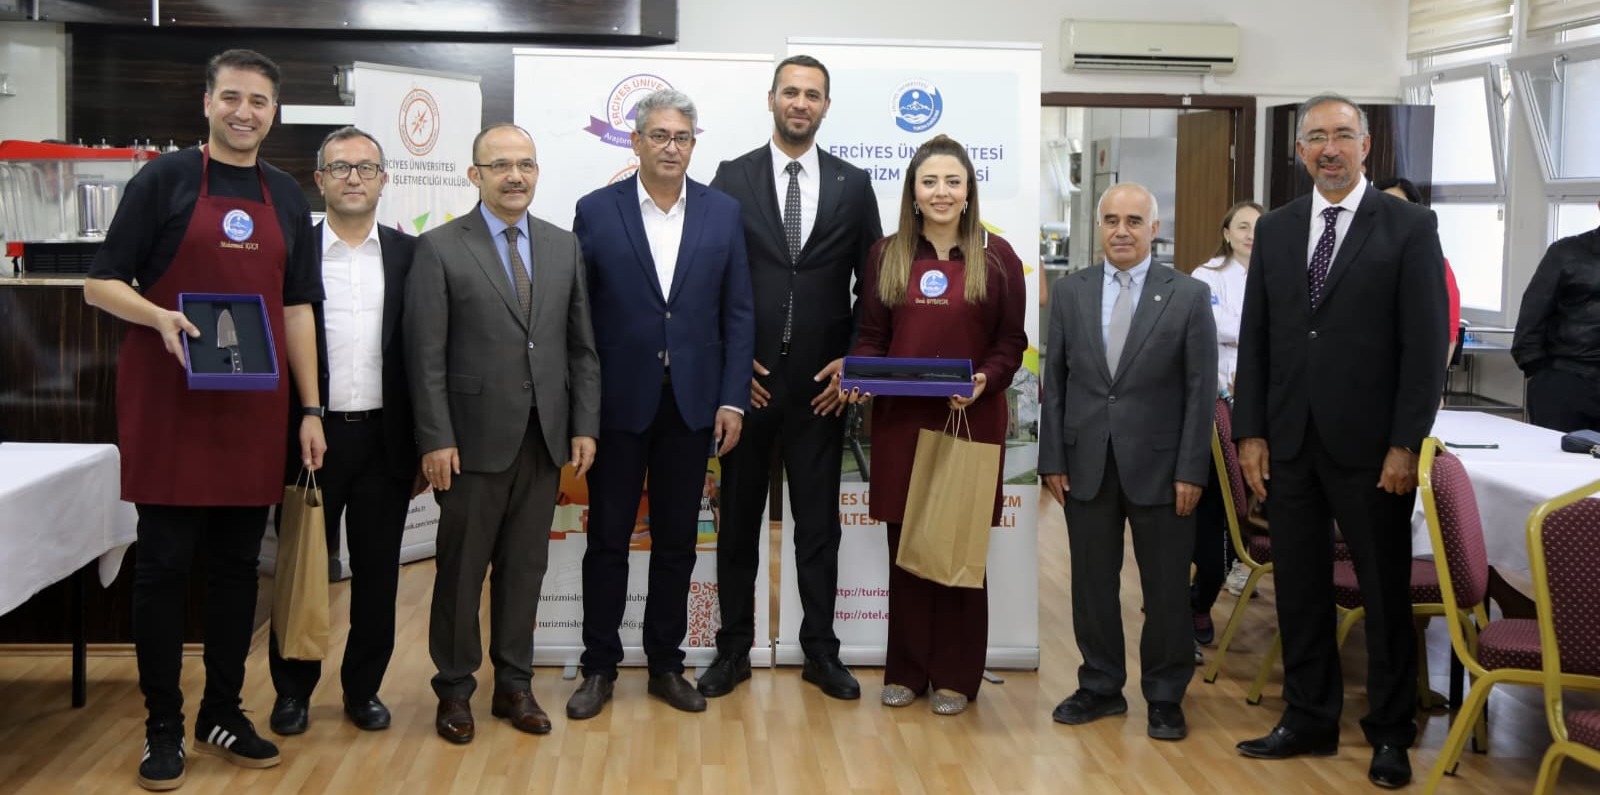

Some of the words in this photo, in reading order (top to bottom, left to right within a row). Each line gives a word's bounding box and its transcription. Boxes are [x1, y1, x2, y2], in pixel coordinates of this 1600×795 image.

[611, 84, 632, 127] ERCİYES
[829, 143, 893, 159] ERCİYES
[384, 159, 409, 170] RCİYES
[410, 159, 456, 172] ÜNİVERSİTESİ
[866, 165, 900, 181] RİZM
